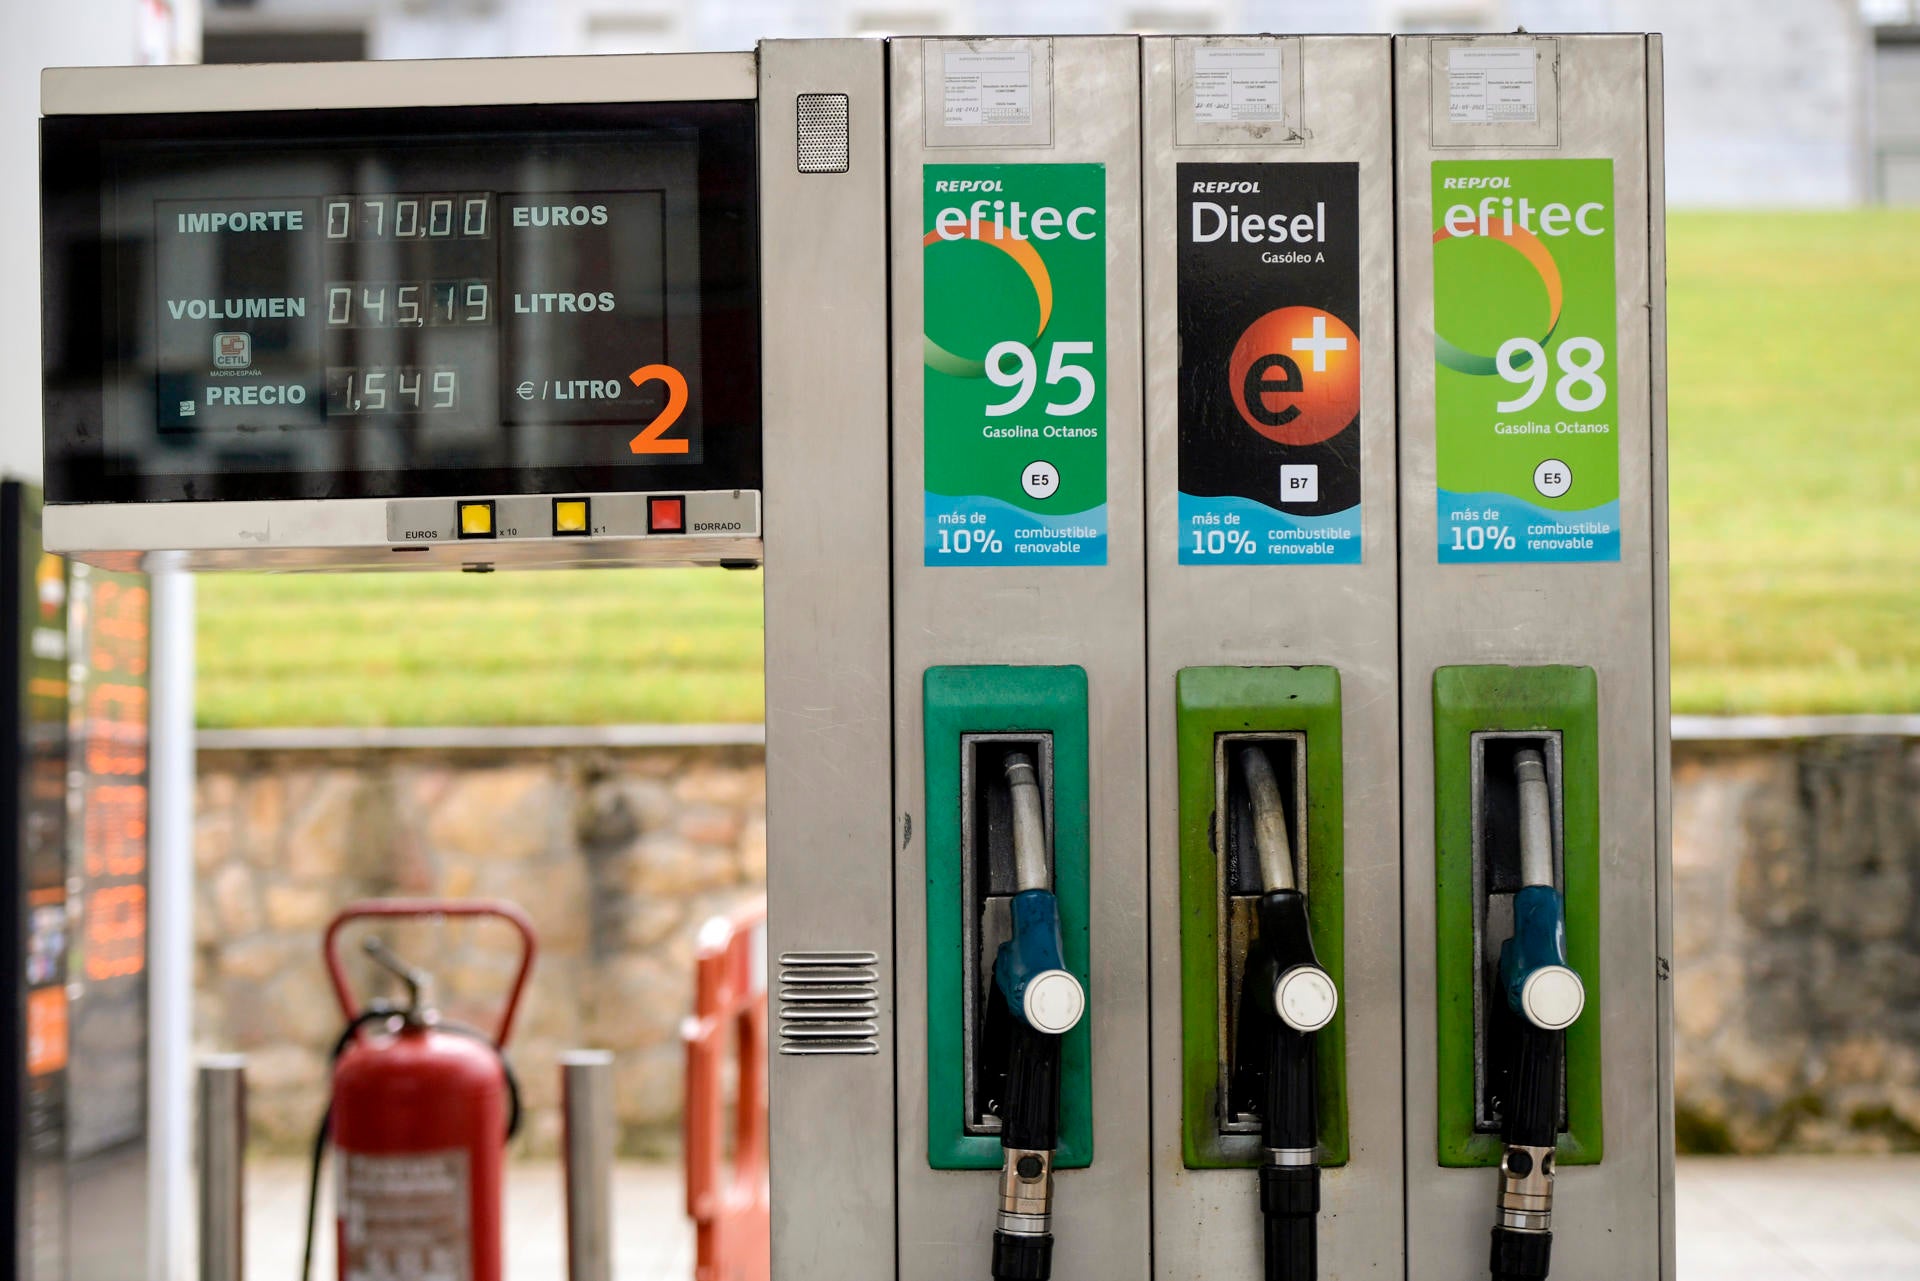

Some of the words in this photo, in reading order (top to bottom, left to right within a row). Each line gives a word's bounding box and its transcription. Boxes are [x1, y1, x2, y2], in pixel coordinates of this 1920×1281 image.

[935, 180, 1004, 192] REPSOL
[1192, 181, 1261, 194] REPSOL
[1443, 176, 1512, 189] REPSOL
[178, 210, 304, 233] IMPORTE
[327, 199, 487, 239] 070,00
[512, 205, 609, 227] EUROS
[935, 199, 1097, 241] efitec
[1192, 201, 1326, 243] Diesel
[1444, 196, 1605, 238] efitec
[1261, 251, 1312, 264] Gasóleo
[1315, 252, 1325, 263] A
[167, 297, 306, 320] VOLUMEN
[328, 284, 488, 328] 045,19
[514, 292, 616, 313] LITROS
[217, 355, 248, 365] CETIL
[984, 340, 1096, 417] 95
[1495, 336, 1607, 414] 98
[206, 384, 306, 405] PRECIO
[346, 371, 455, 411] 1,549
[516, 381, 535, 400] €
[555, 379, 622, 400] LITRO
[628, 363, 689, 454] 2
[982, 425, 1039, 438] Gasolina
[1042, 425, 1098, 438] Octanos
[1494, 421, 1551, 434] Gasolina
[1554, 421, 1610, 434] Octanos
[1031, 475, 1049, 486] E5
[1289, 478, 1308, 489] B7
[1543, 473, 1562, 484] E5
[938, 511, 966, 524] más
[970, 511, 987, 524] de
[1192, 511, 1220, 525] más
[1223, 511, 1241, 525] de
[1451, 507, 1479, 521] más
[1483, 507, 1500, 521] de
[694, 522, 741, 532] BORRADO
[1014, 526, 1097, 539] combustible
[1527, 523, 1610, 535] combustible
[405, 530, 438, 540] EUROS
[1268, 528, 1351, 540] combustible
[1451, 525, 1517, 551] 10%
[938, 529, 1003, 554] 10%
[1014, 542, 1081, 553] renovable
[1192, 530, 1257, 555] 10%
[1527, 537, 1594, 550] renovable
[1268, 543, 1335, 555] renovable
